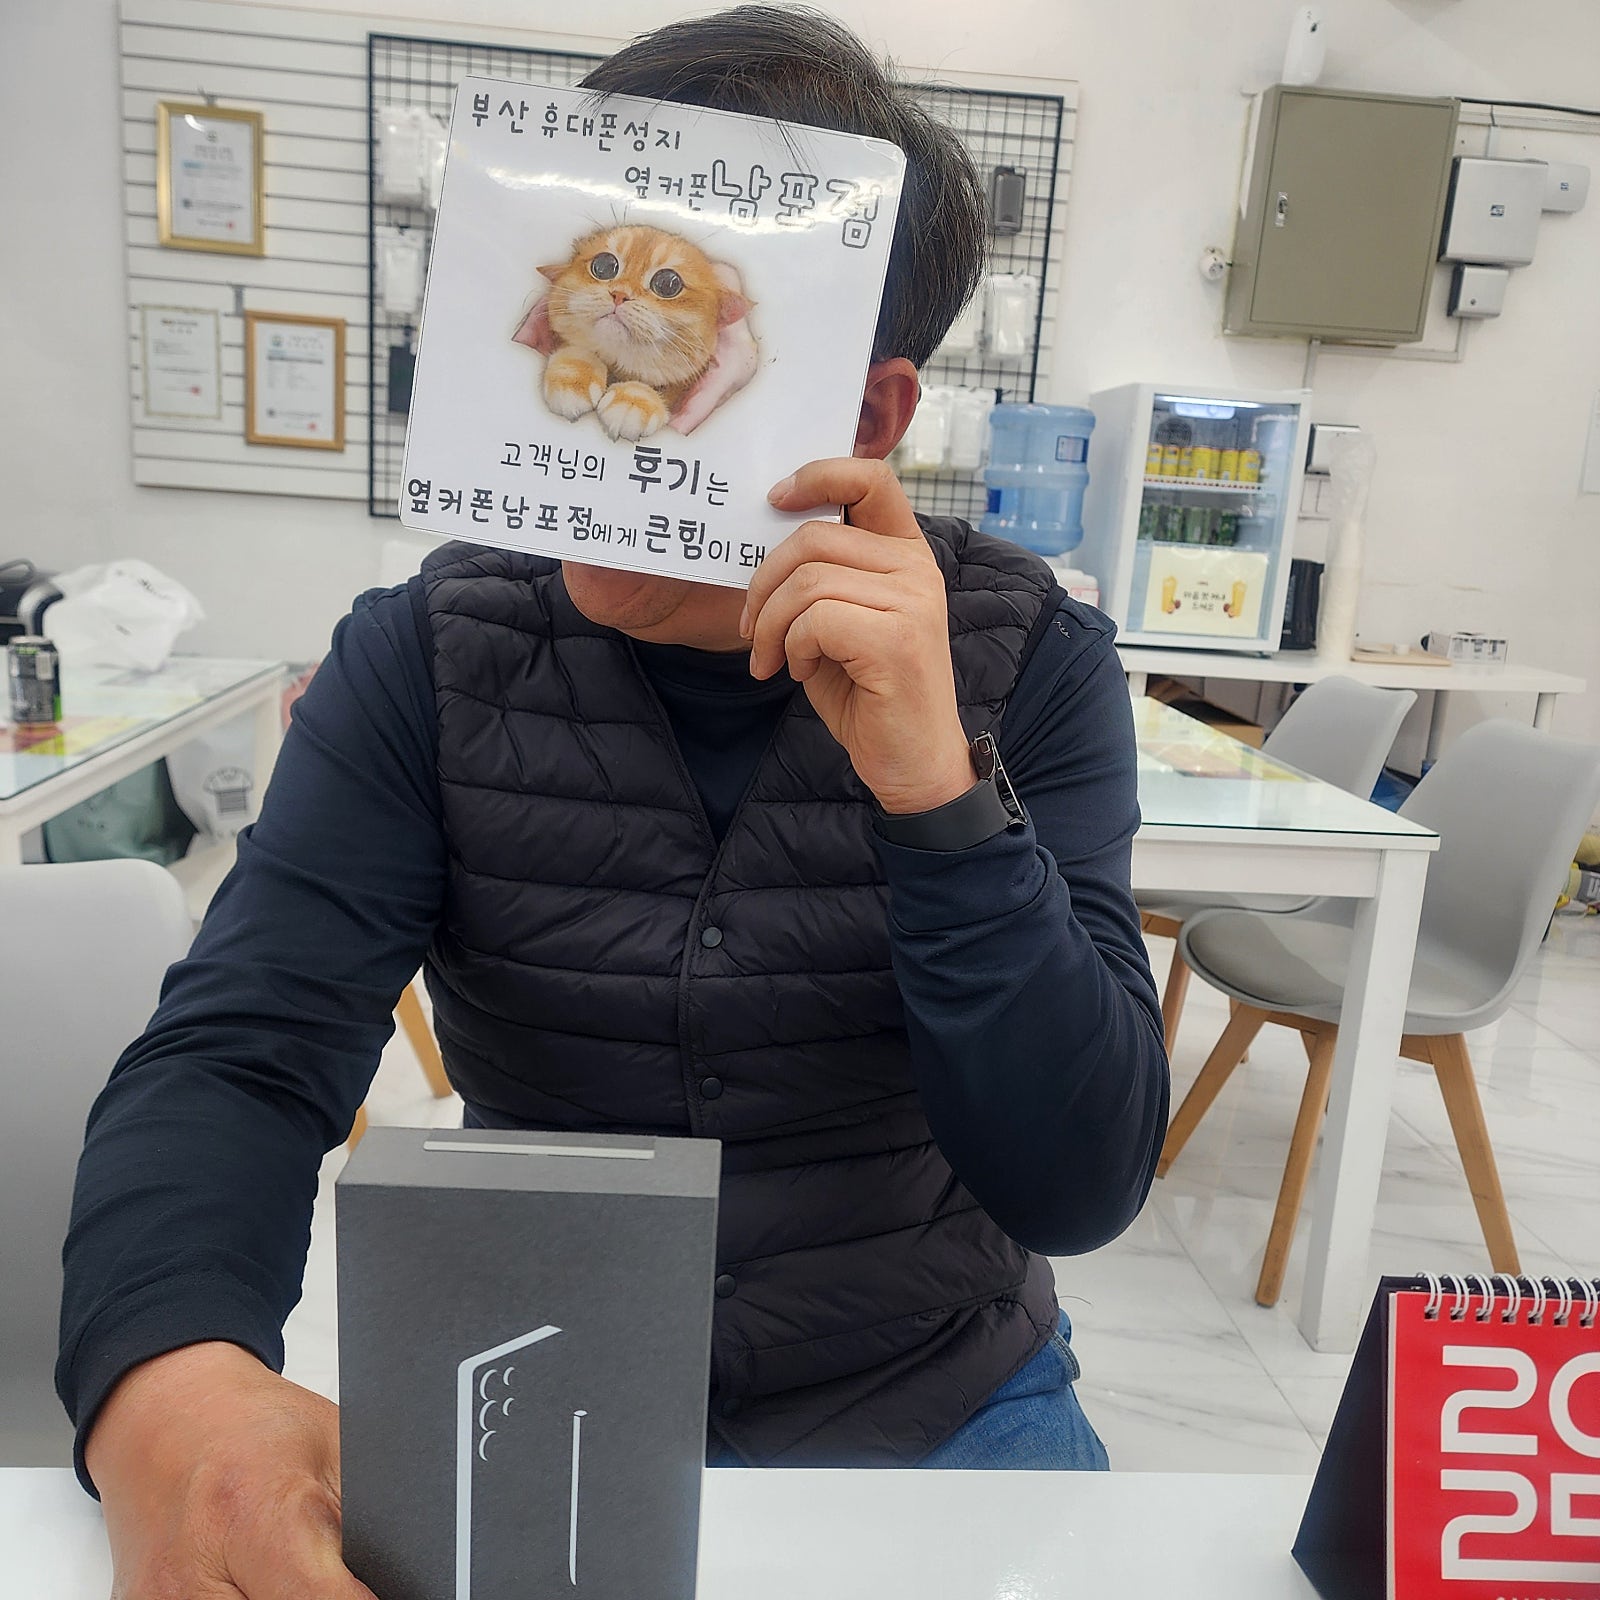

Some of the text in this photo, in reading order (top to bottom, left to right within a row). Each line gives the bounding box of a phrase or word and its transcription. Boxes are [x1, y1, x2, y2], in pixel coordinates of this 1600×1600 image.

[471, 93, 681, 152] 부산 휴대폰성지
[500, 441, 730, 506] 고객님의 후기는
